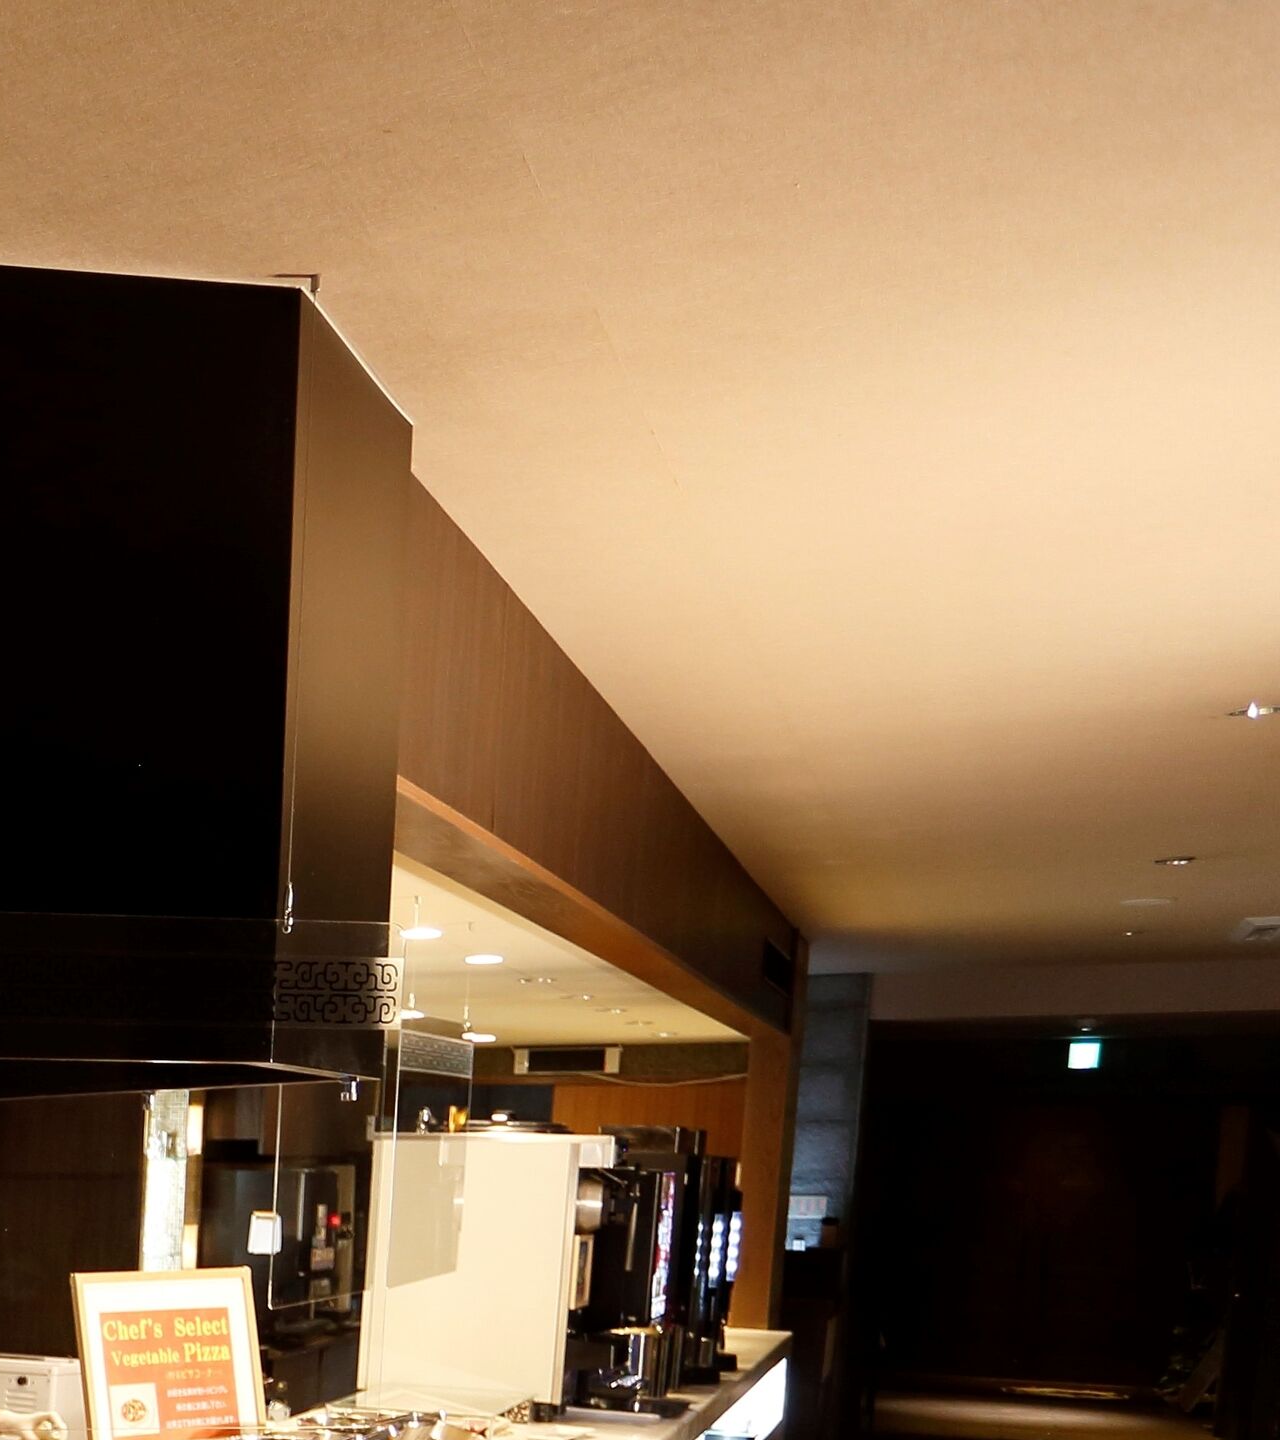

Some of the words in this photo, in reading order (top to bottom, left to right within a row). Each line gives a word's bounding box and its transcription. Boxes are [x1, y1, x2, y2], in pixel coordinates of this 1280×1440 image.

[103, 1318, 163, 1342] Chef's
[174, 1316, 228, 1337] Select
[111, 1347, 180, 1367] Vegetable
[183, 1341, 231, 1363] Pizza
